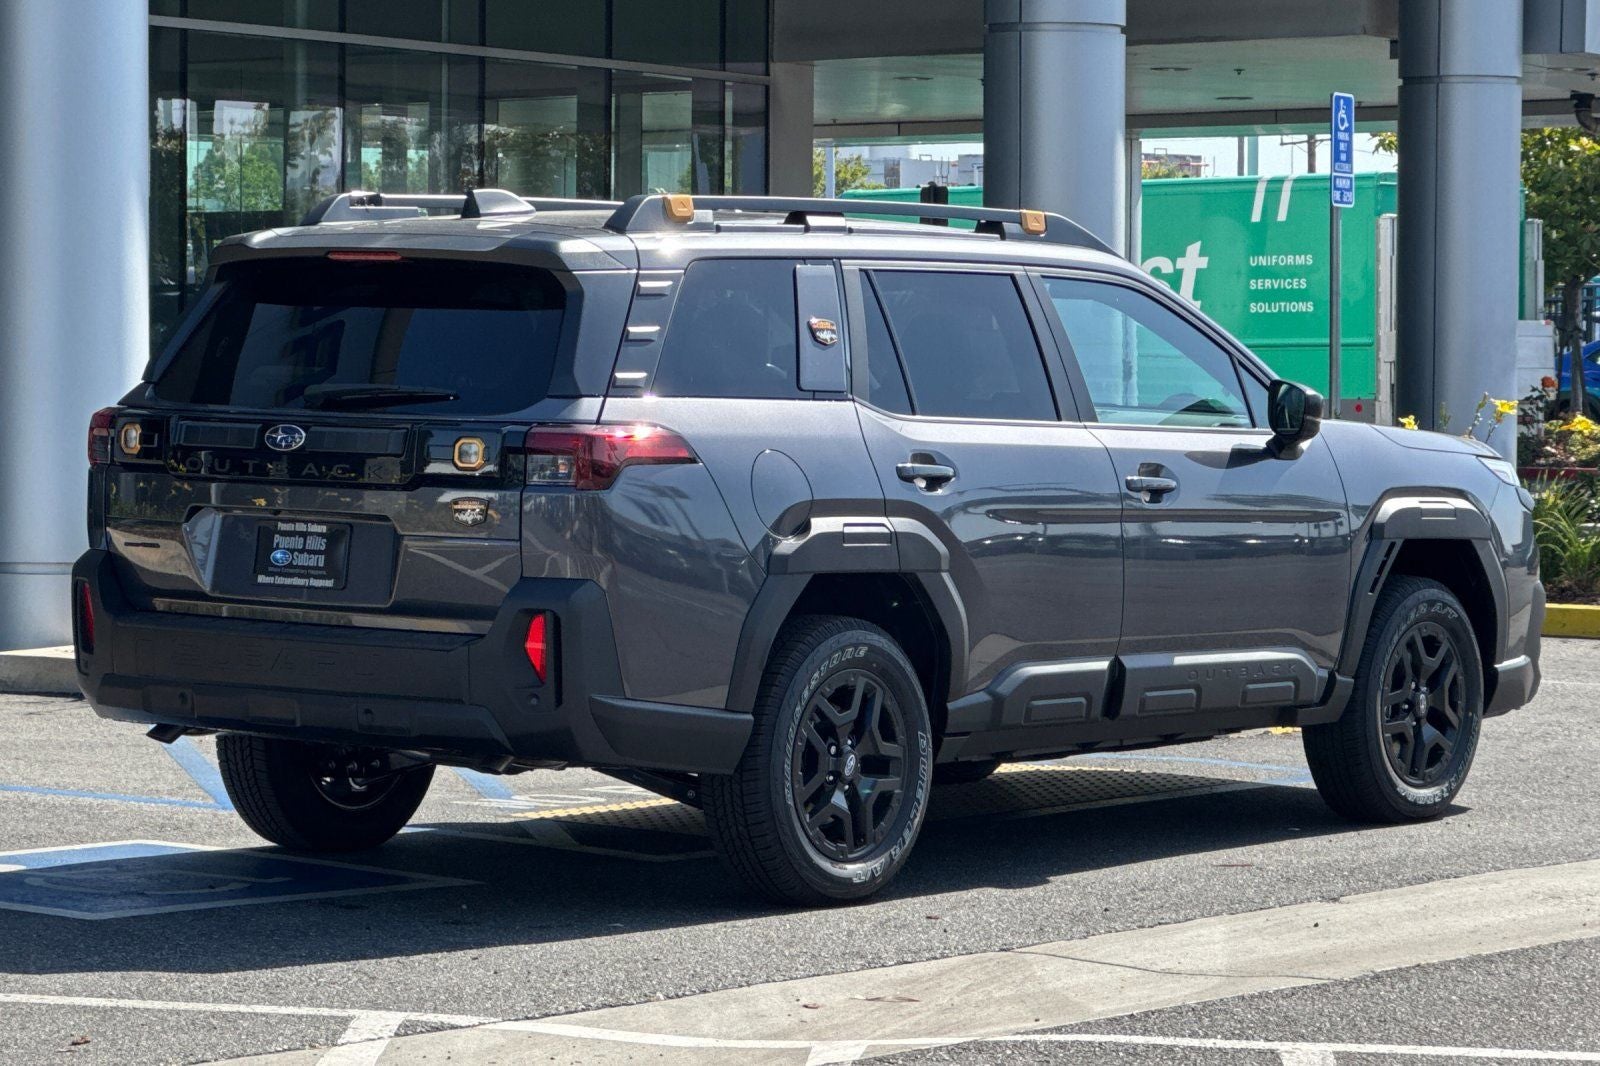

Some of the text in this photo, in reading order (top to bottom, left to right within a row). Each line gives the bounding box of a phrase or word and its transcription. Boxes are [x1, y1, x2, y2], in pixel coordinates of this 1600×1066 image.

[1250, 254, 1313, 266] UNIFORMS
[1250, 278, 1307, 289] SERVICES
[1250, 302, 1314, 313] SOLUTIONS
[185, 457, 384, 480] OUTBACK
[273, 534, 327, 551] Puente Hills
[292, 551, 325, 567] Subaru
[1187, 663, 1297, 682] OUTBACK
